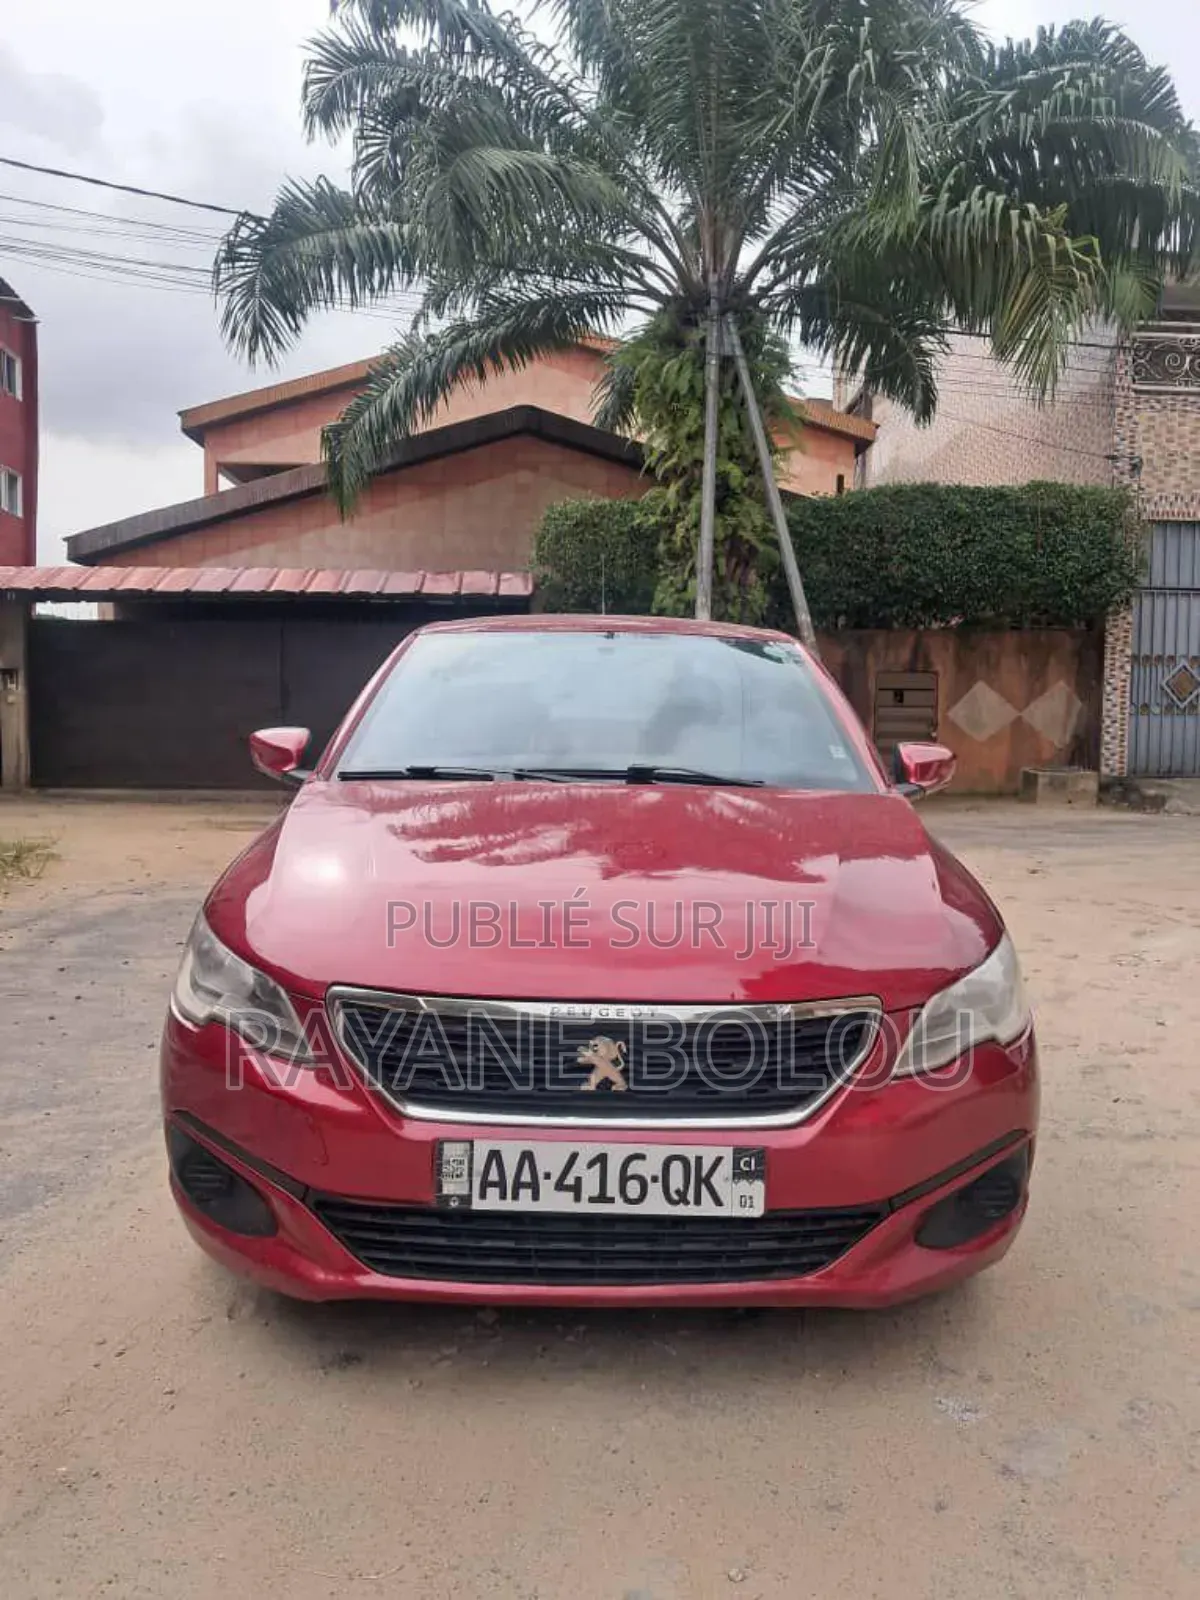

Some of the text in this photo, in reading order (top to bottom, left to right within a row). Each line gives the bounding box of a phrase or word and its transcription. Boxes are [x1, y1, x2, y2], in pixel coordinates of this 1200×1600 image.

[549, 1006, 658, 1017] PEUGEOT
[740, 1156, 755, 1171] CI
[478, 1149, 724, 1207] AA-416-QK
